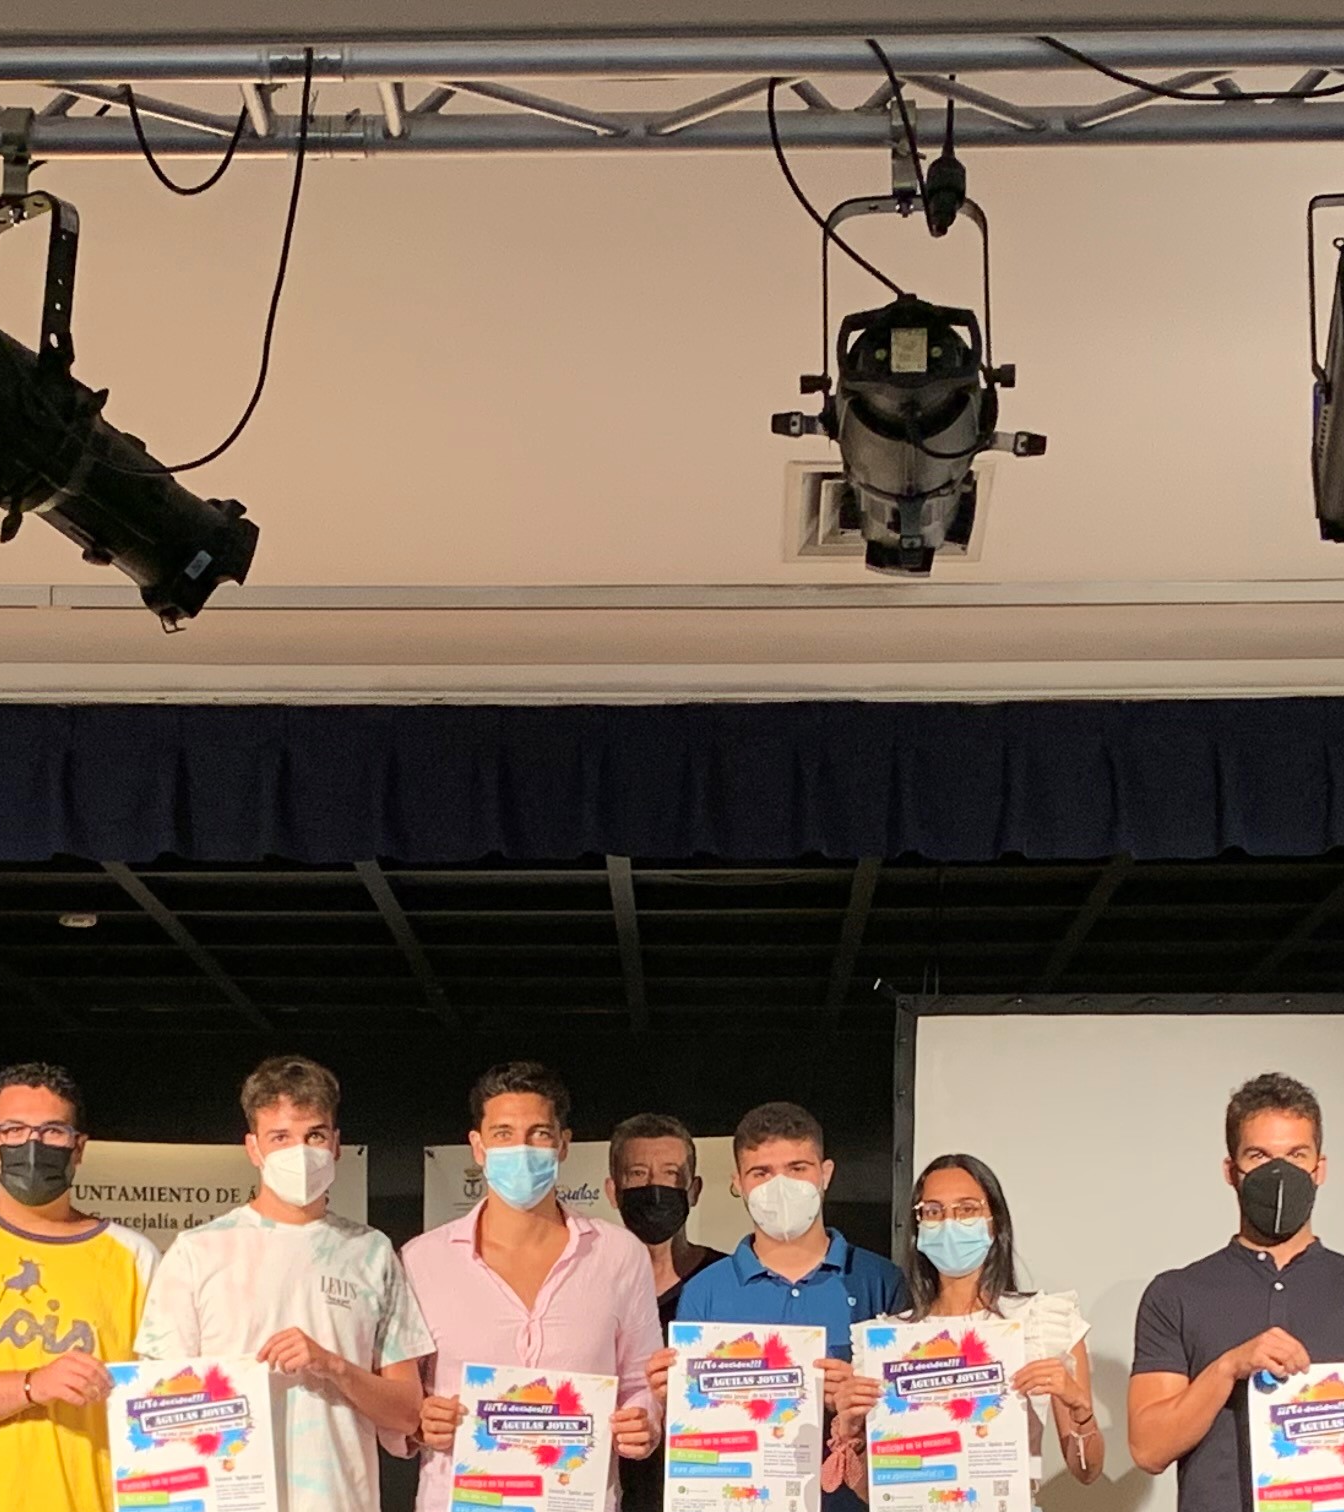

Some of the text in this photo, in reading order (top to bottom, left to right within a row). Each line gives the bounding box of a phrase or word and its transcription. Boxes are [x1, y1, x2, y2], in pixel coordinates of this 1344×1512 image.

[71, 1185, 210, 1203] UNTAMIENTO
[216, 1187, 242, 1203] DE
[184, 1214, 206, 1229] de
